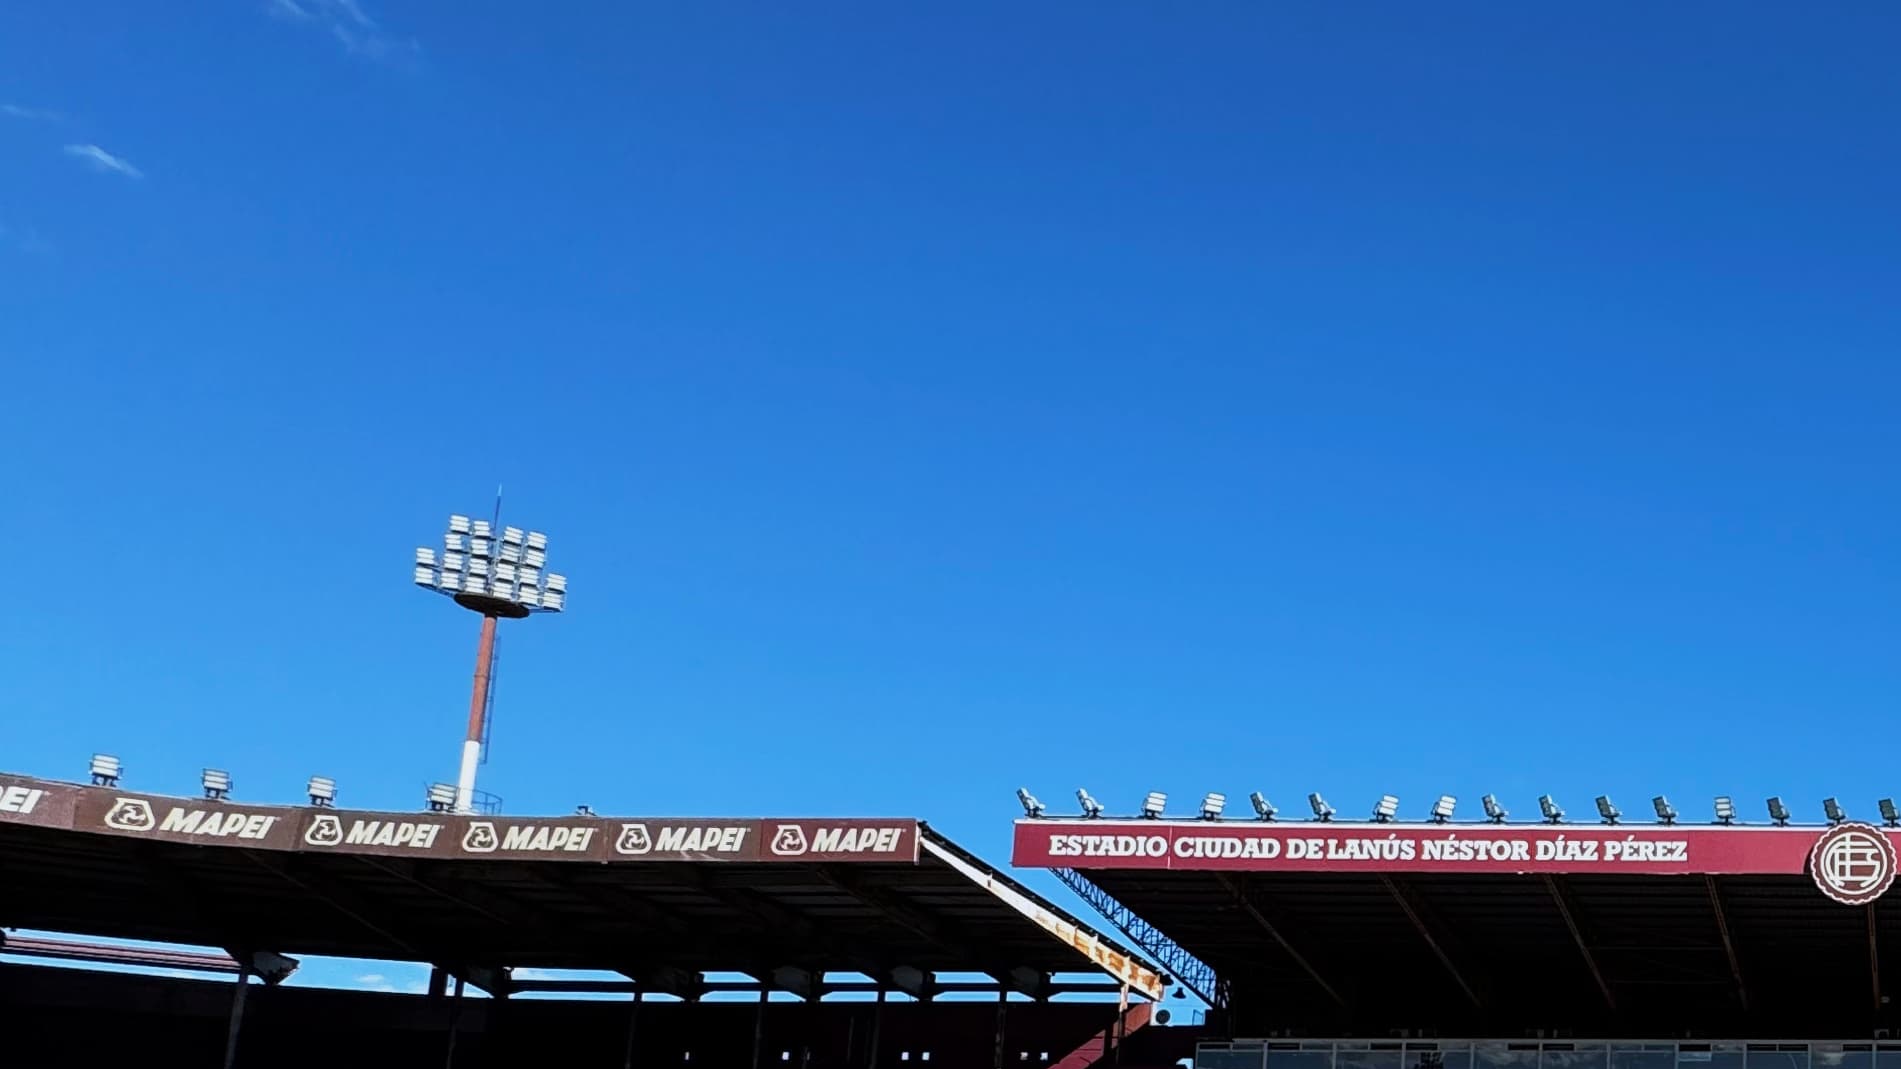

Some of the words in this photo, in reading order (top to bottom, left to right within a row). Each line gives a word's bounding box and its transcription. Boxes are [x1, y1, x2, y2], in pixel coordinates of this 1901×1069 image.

[160, 806, 274, 840] MAPEI
[346, 820, 439, 849] MAPEI
[501, 825, 594, 852] MAPEI
[655, 826, 746, 853] MAPEI
[811, 827, 902, 853] MAPEI
[1048, 834, 1169, 858] ESTADIO
[1173, 836, 1281, 859] CIUDAD
[1285, 837, 1324, 860] DE
[1326, 832, 1416, 861] LANÚS
[1421, 832, 1531, 862] NÉSTOR
[1535, 834, 1599, 862] DÍAZ
[1603, 834, 1689, 862] PÉREZ
